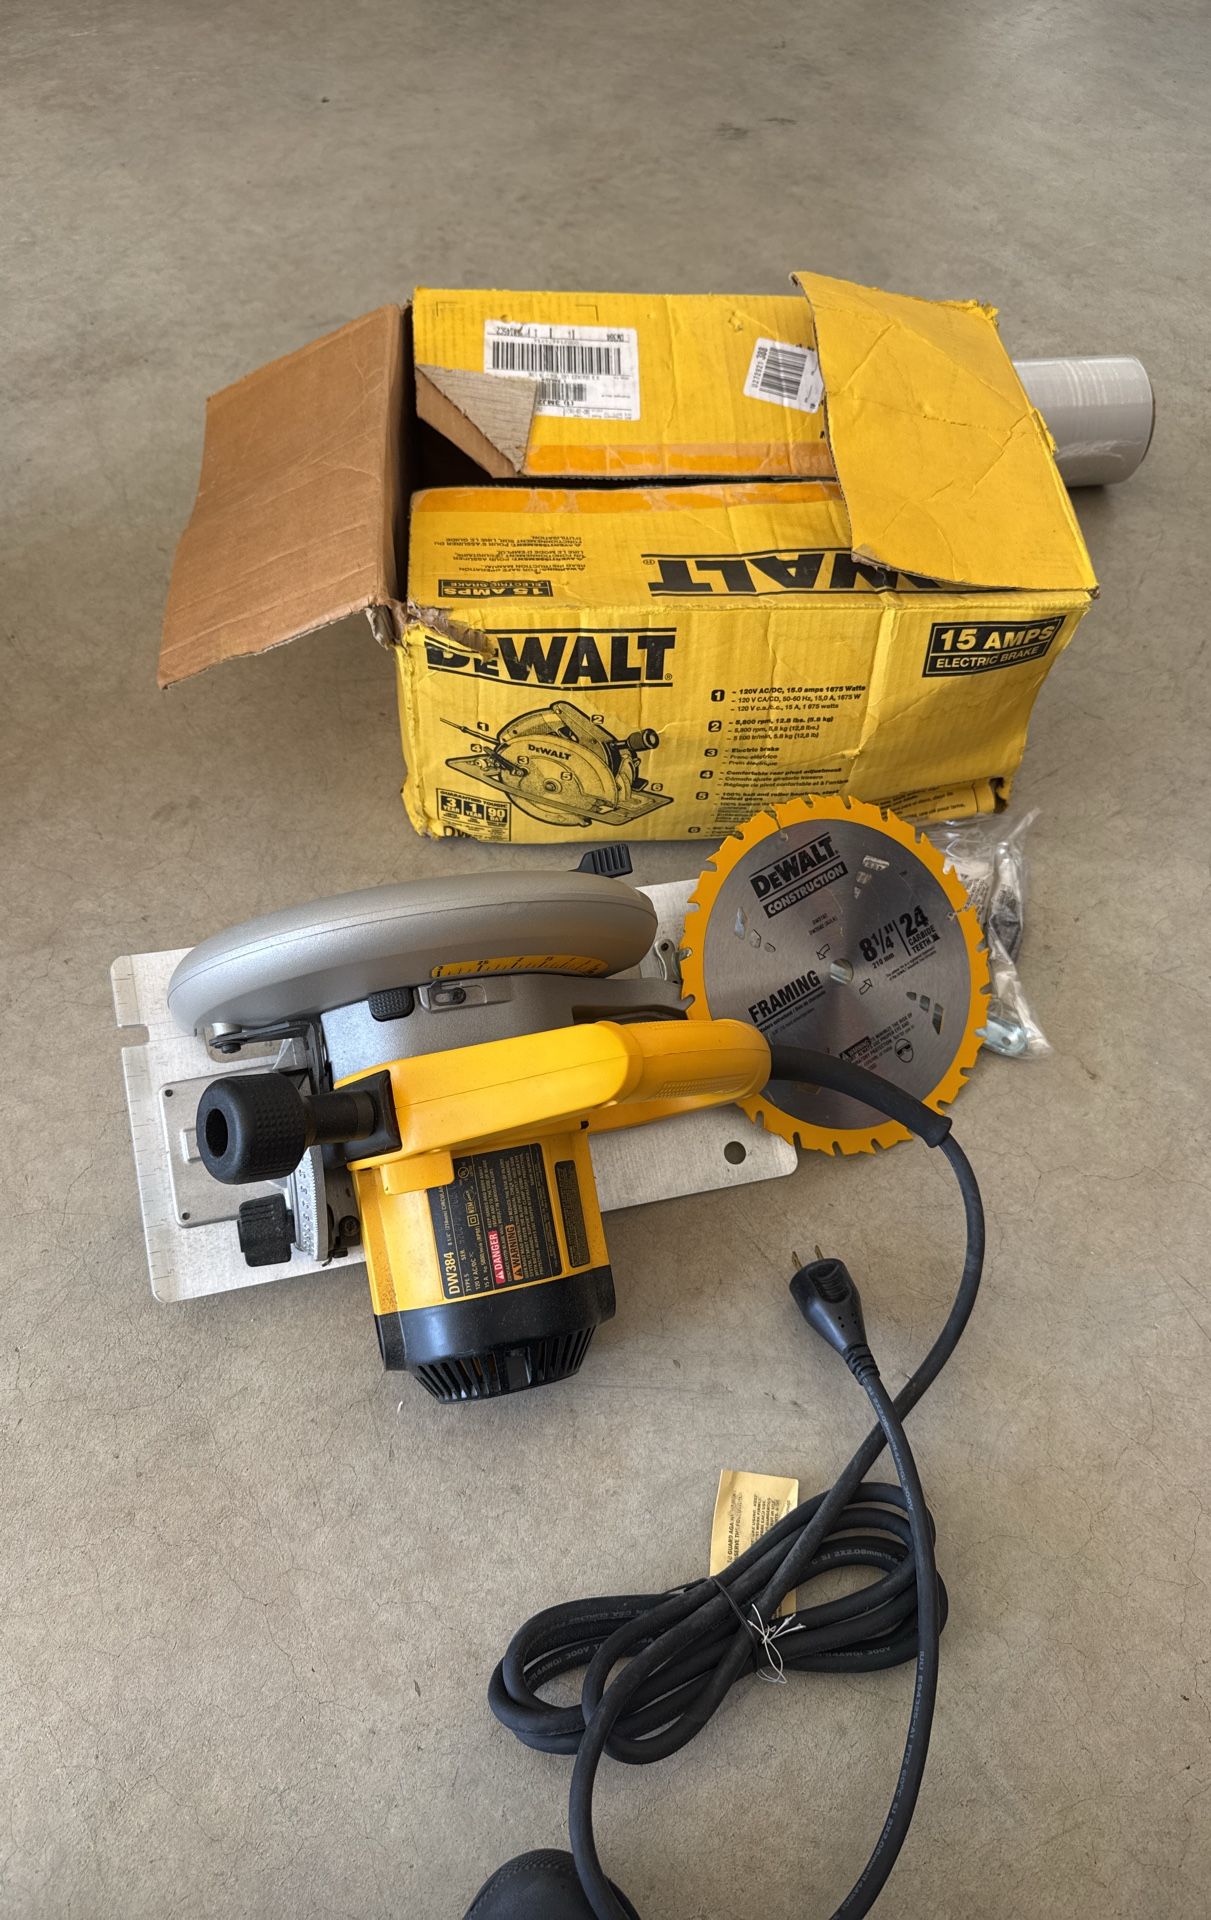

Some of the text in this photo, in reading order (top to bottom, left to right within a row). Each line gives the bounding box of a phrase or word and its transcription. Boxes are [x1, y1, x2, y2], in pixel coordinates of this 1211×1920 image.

[940, 623, 1054, 652] 15 AMPS
[936, 646, 1038, 669] ELECTRIC BRAKE
[528, 743, 571, 760] DEWALT
[446, 797, 457, 807] 3
[468, 803, 477, 812] 1
[487, 807, 505, 818] 90
[749, 836, 837, 898] DEWALT
[765, 864, 845, 915] CONSTRUCTION
[896, 903, 931, 938] 24
[906, 923, 937, 946] CARBIDE
[910, 936, 932, 954] TEETH
[747, 968, 821, 1023] FRAMING
[489, 1233, 503, 1270] DANGER
[506, 1226, 521, 1267] WARNING
[442, 1251, 461, 1295] DW384
[464, 1277, 472, 1292] TYPE
